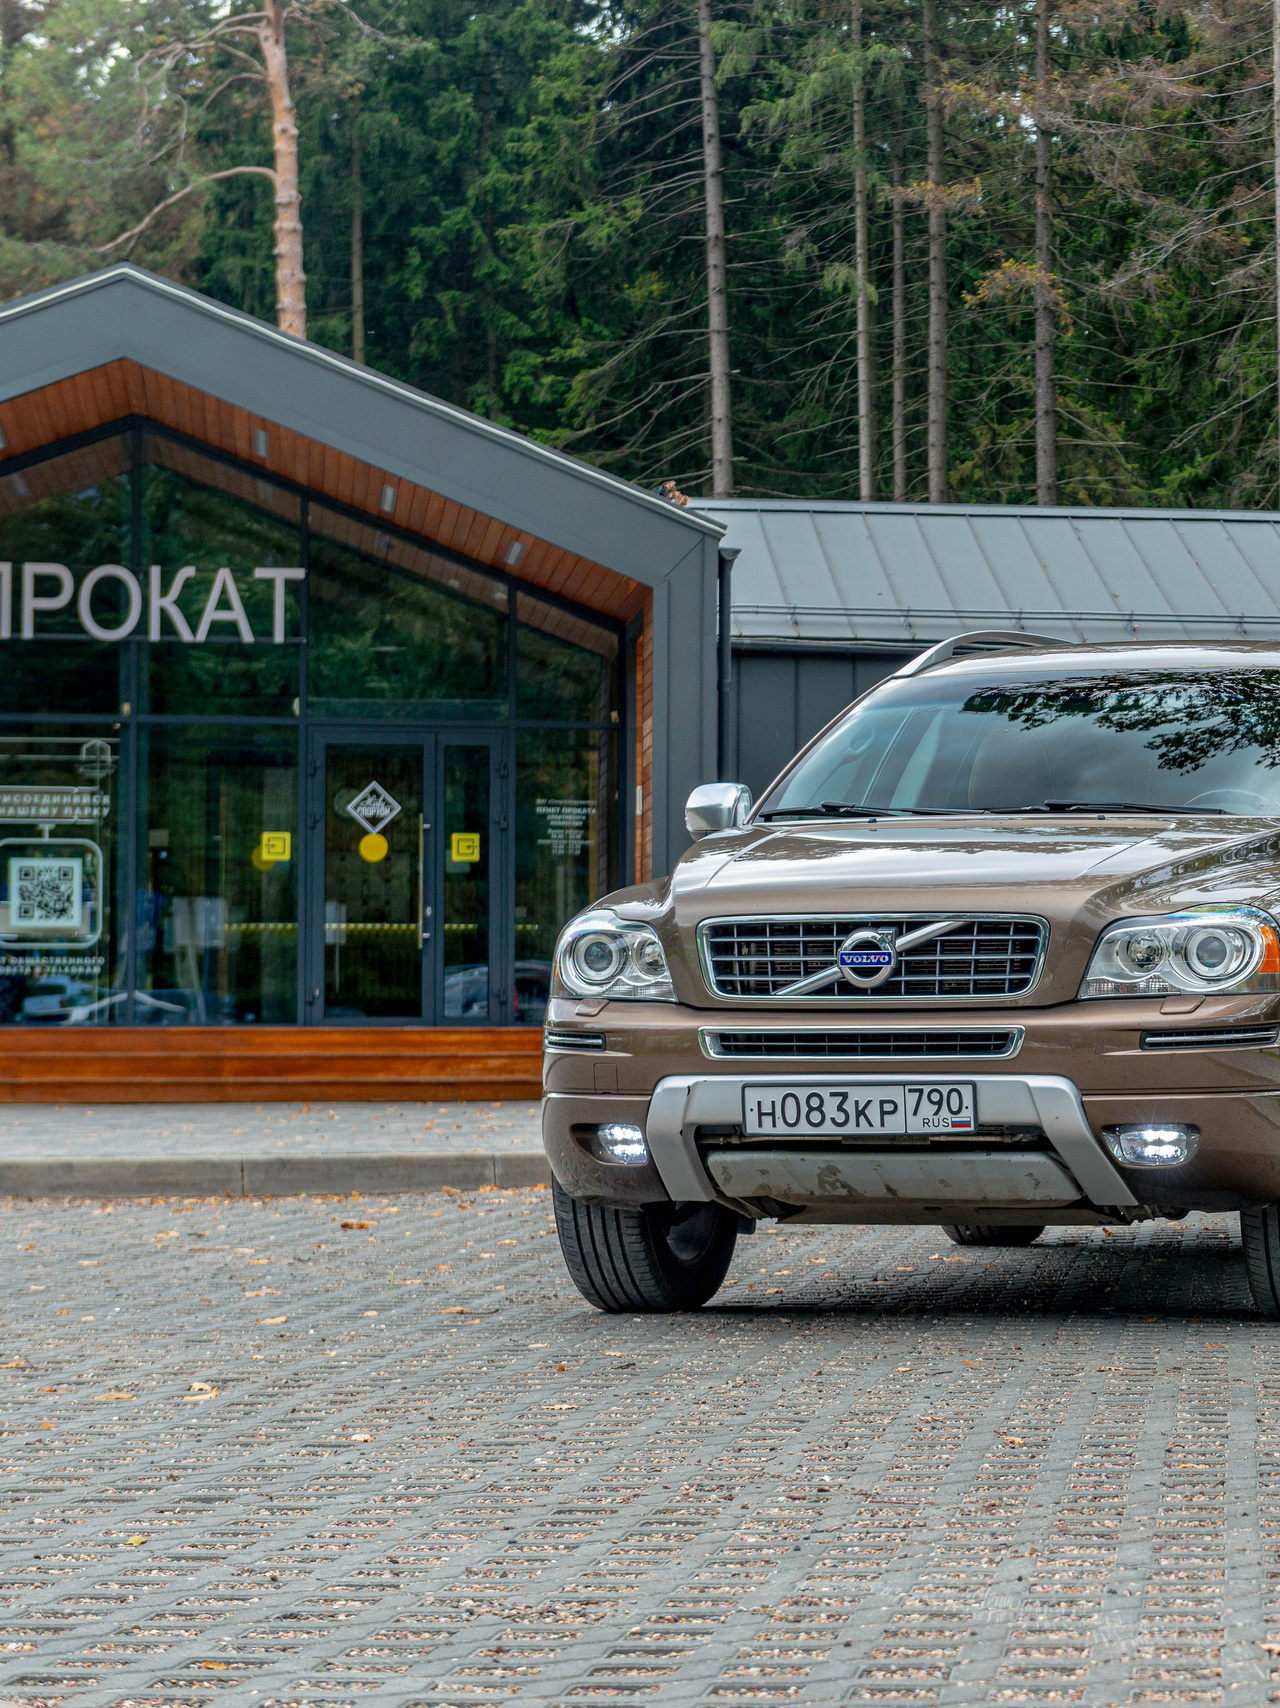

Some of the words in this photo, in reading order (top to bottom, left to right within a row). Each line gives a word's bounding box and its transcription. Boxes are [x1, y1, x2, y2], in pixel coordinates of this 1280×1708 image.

[0, 561, 306, 644] РОКАТ
[0, 793, 111, 806] ИСОЕДИНЯЙСЯ
[62, 805, 110, 818] ПАРКУ
[536, 806, 561, 814] ПУНКТ
[561, 806, 597, 814] ПРОКАТА
[842, 954, 890, 964] VOLVO
[756, 1090, 899, 1128] Н083КР
[907, 1087, 964, 1117] 790
[922, 1117, 950, 1128] RUS
